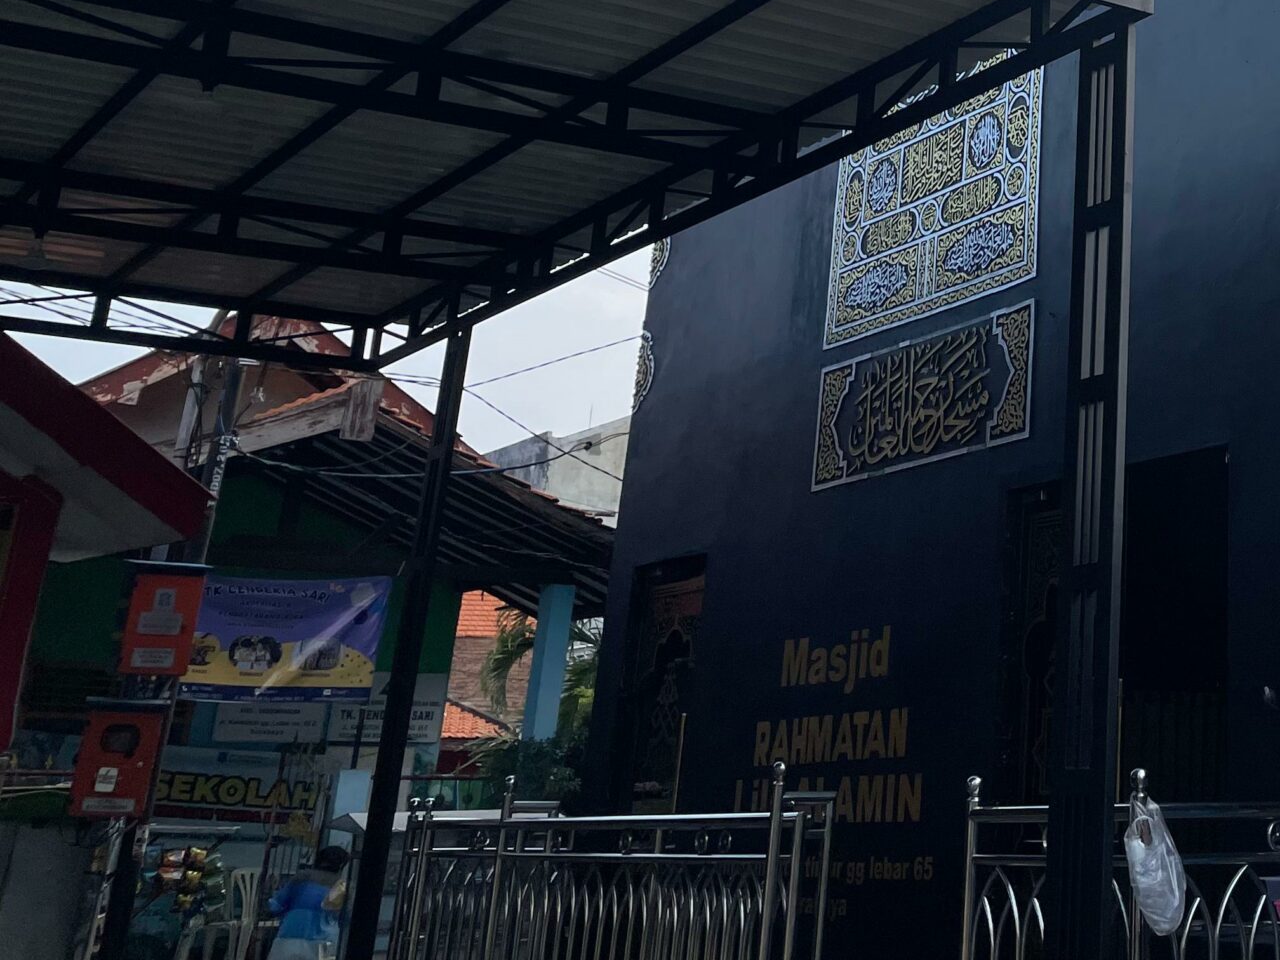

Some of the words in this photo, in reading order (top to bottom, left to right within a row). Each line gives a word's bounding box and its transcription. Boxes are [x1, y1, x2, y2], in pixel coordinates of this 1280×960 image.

[780, 624, 892, 695] Masjid
[753, 706, 910, 767] RAHMATAN
[846, 861, 865, 886] gg
[869, 856, 909, 881] lebar
[912, 855, 934, 881] 65
